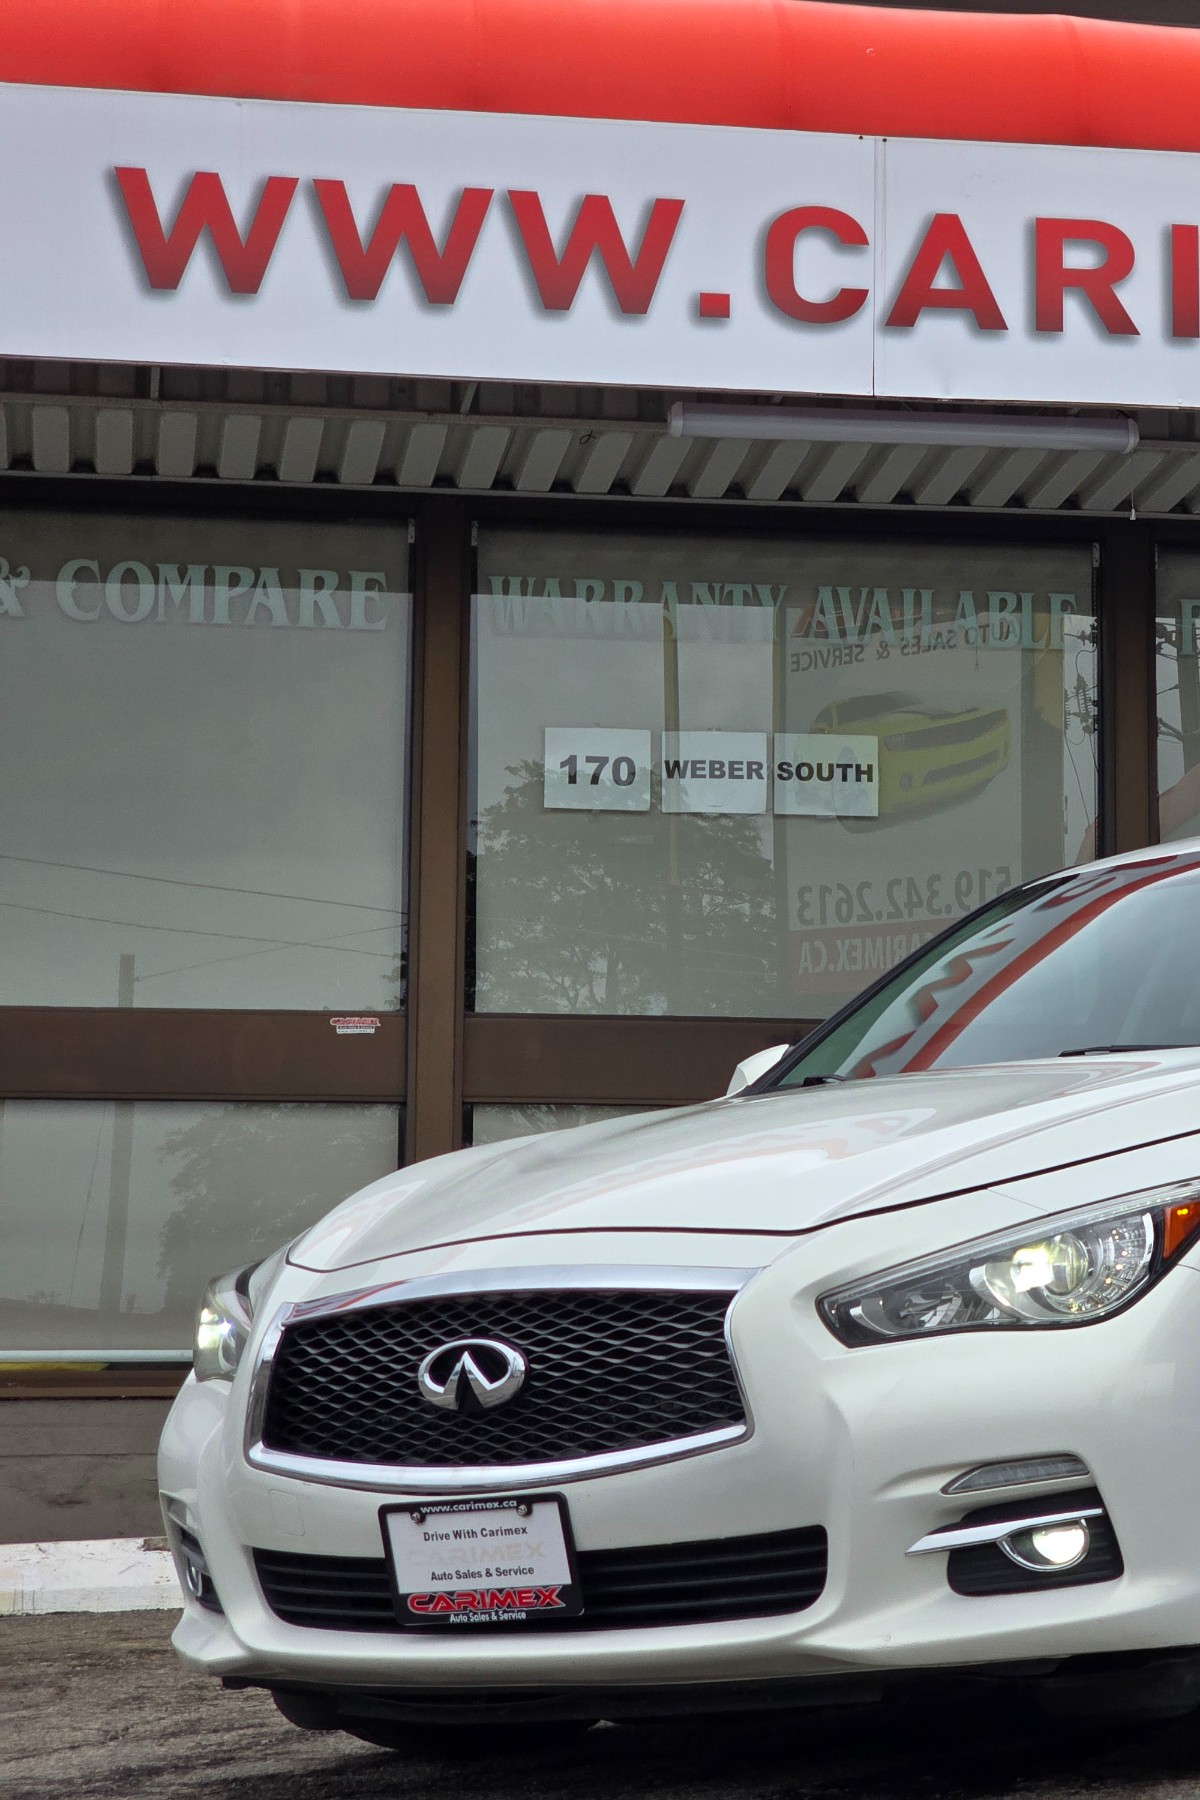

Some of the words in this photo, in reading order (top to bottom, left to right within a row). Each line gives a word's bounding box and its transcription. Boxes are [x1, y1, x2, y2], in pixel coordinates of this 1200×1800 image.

[56, 558, 388, 631] COMPARE
[488, 576, 787, 641] WARRANTY
[812, 586, 1076, 651] AVAILABLE
[559, 755, 637, 788] 170
[663, 758, 765, 781] WEBER
[776, 760, 875, 784] SOUTH
[420, 1500, 517, 1514] www.carimex.ca
[423, 1531, 451, 1542] Drive
[453, 1529, 478, 1540] With
[480, 1526, 528, 1538] Carimex
[431, 1571, 453, 1582] Auto
[455, 1568, 482, 1580] Sales
[485, 1567, 493, 1578] &
[495, 1565, 535, 1577] Service
[407, 1585, 566, 1615] CARIMEX
[450, 1612, 469, 1623] Auto
[469, 1611, 490, 1623] Sales
[491, 1611, 498, 1621] &
[499, 1611, 527, 1621] Service
